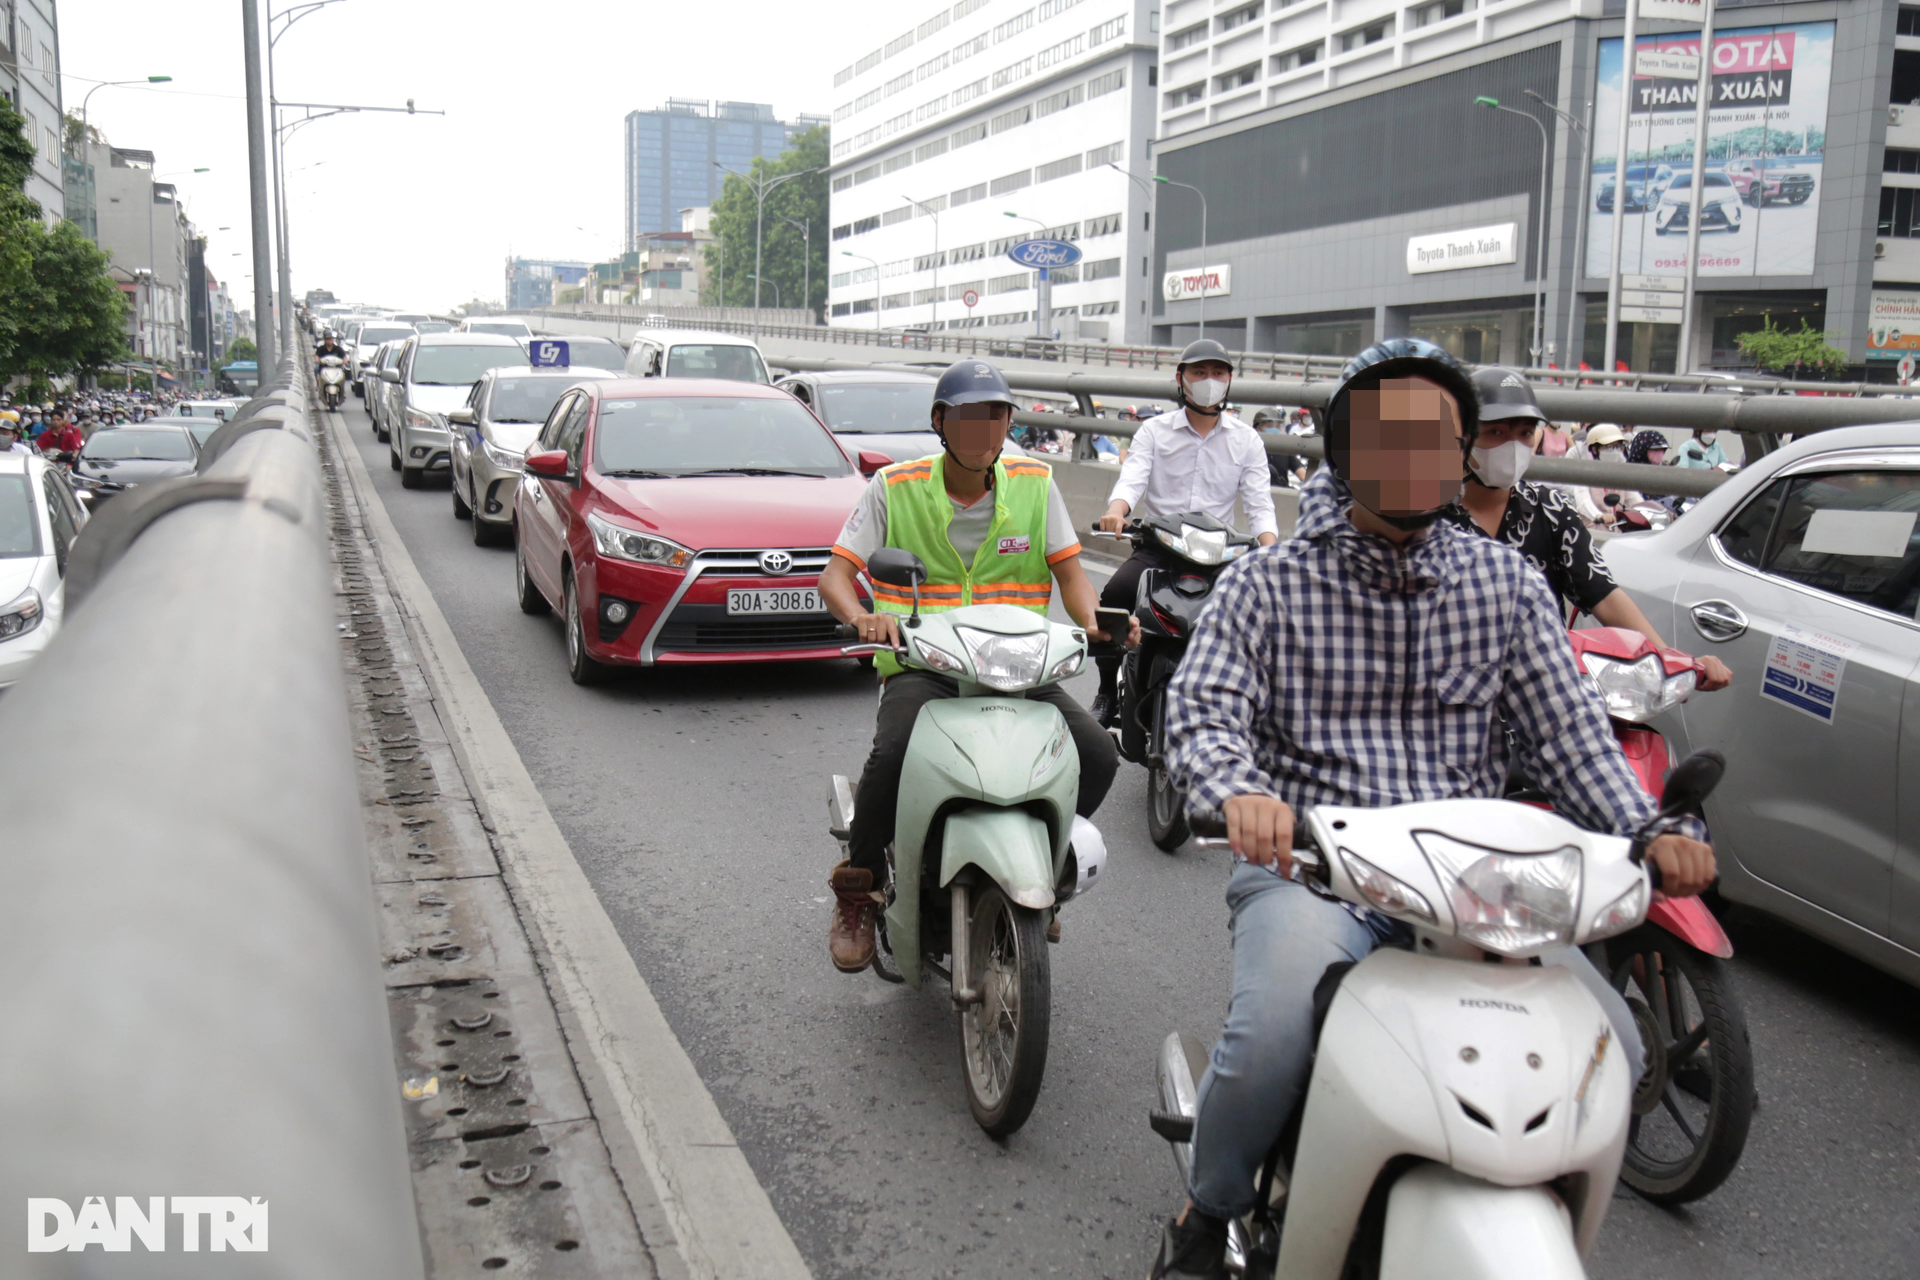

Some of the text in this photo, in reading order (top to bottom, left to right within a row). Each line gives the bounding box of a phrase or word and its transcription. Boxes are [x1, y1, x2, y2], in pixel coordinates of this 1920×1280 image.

[1638, 58, 1659, 68] Toyota
[1661, 60, 1680, 69] Thanh
[1719, 76, 1784, 101] XUÂN
[1024, 243, 1068, 264] Ford
[1417, 238, 1501, 263] Toyota Thanh Xuân
[1182, 273, 1221, 292] TOYOTA
[1875, 303, 1902, 314] CHÍNH
[540, 342, 560, 364] G7
[980, 705, 1018, 714] HONDA
[1459, 998, 1530, 1016] HONDA
